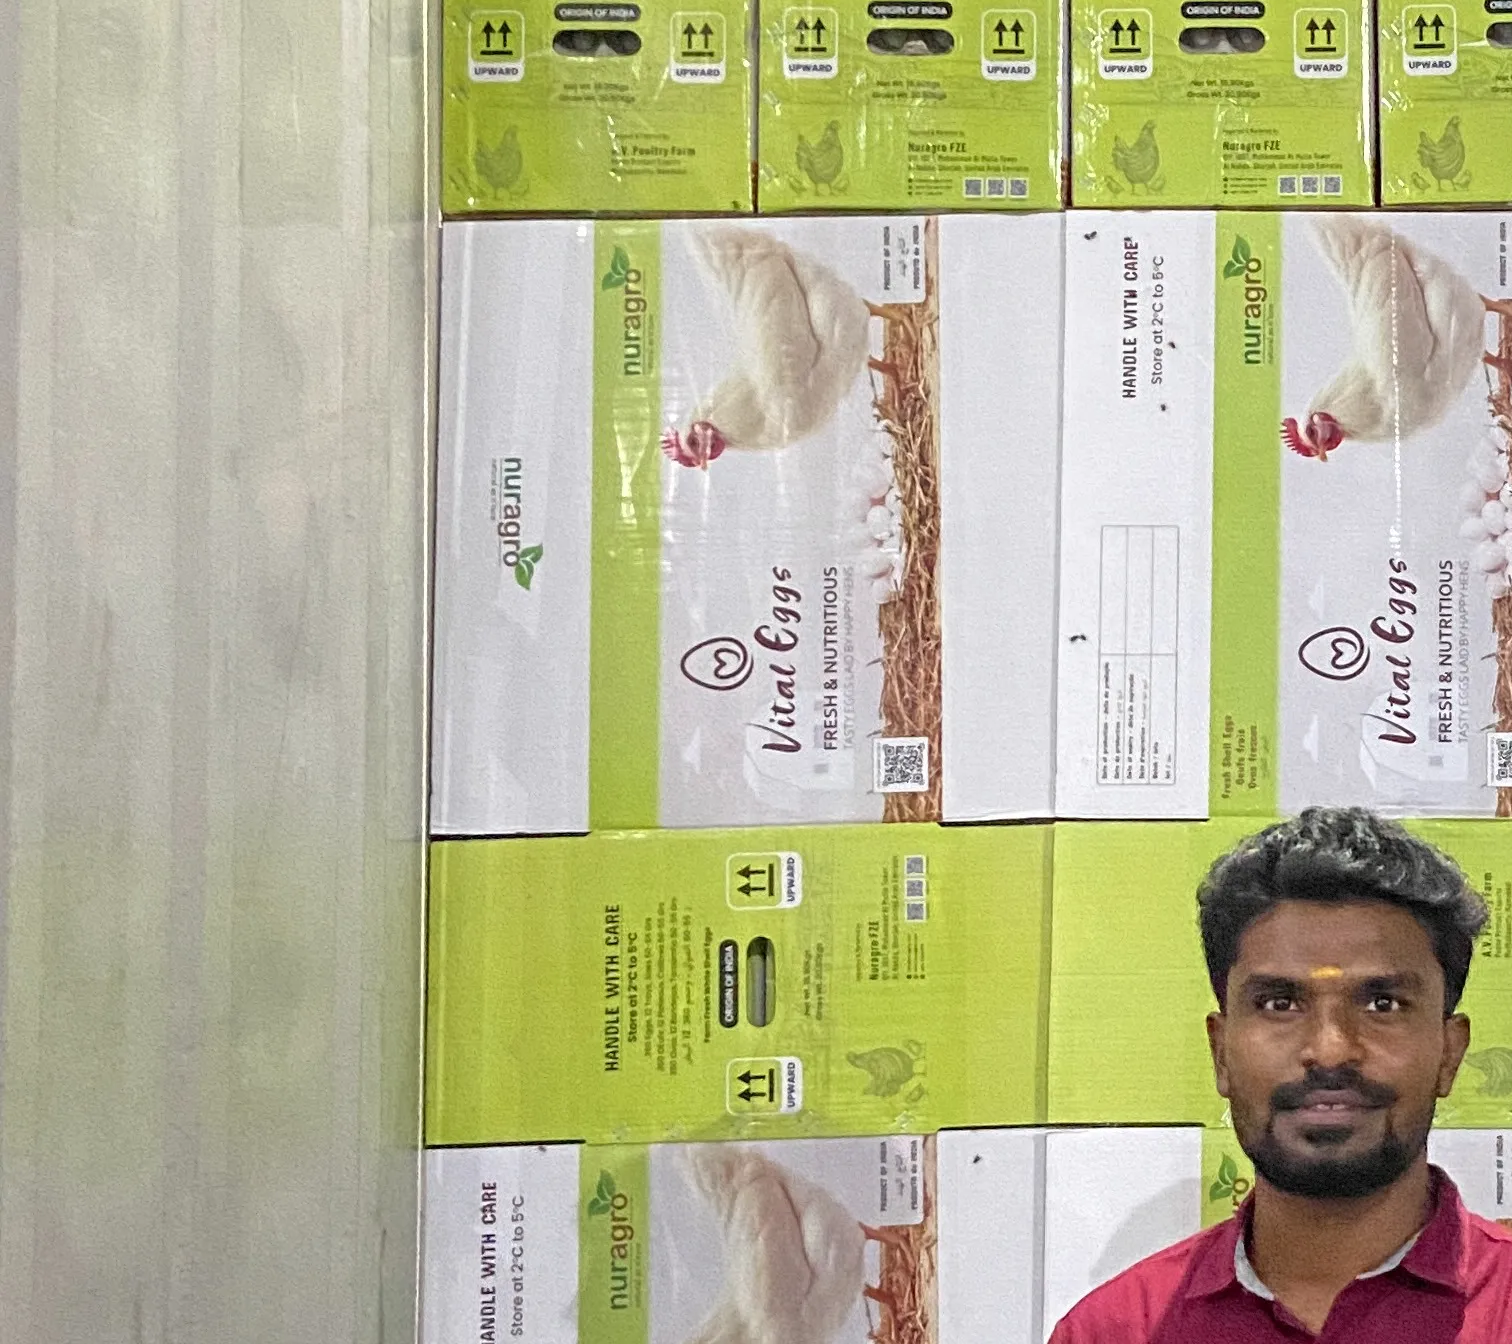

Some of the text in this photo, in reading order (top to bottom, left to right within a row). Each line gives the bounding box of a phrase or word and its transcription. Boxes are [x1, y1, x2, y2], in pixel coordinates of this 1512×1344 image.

[1187, 5, 1260, 15] ORIGIN OF INDIA
[987, 65, 1031, 76] UPWARD
[1104, 63, 1148, 74] UPWARD
[1408, 60, 1452, 71] UPWARD
[1223, 140, 1281, 153] Nuragro FZE
[1152, 284, 1163, 297] to
[624, 268, 646, 376] nuragro
[1123, 241, 1138, 398] HANDLE WITH CARE
[1245, 258, 1267, 364] nuragro
[1152, 330, 1163, 344] at
[1152, 348, 1163, 384] Store
[498, 457, 522, 567] nuragro
[1458, 560, 1470, 591] HENS
[1458, 592, 1470, 629] HAPPY
[1360, 558, 1417, 744] Vital Eggs
[1439, 560, 1453, 743] FRESH & NUTRITIOUS
[1458, 629, 1470, 646] BY
[746, 566, 801, 753] Vital Eggs
[824, 567, 838, 750] FRESH & NUTRITIOUS
[1458, 675, 1470, 707] EGGS
[1458, 709, 1470, 744] TASTY
[1222, 715, 1234, 798] Fresh Shell Eggs
[787, 857, 795, 902] UPWARD
[605, 904, 620, 1072] HANDLE WITH CARE
[483, 1182, 496, 1225] CARE
[512, 1227, 524, 1242] to
[611, 1193, 634, 1309] nuragro
[482, 1234, 495, 1278] WITH
[512, 1277, 523, 1292] at
[512, 1299, 523, 1336] Store
